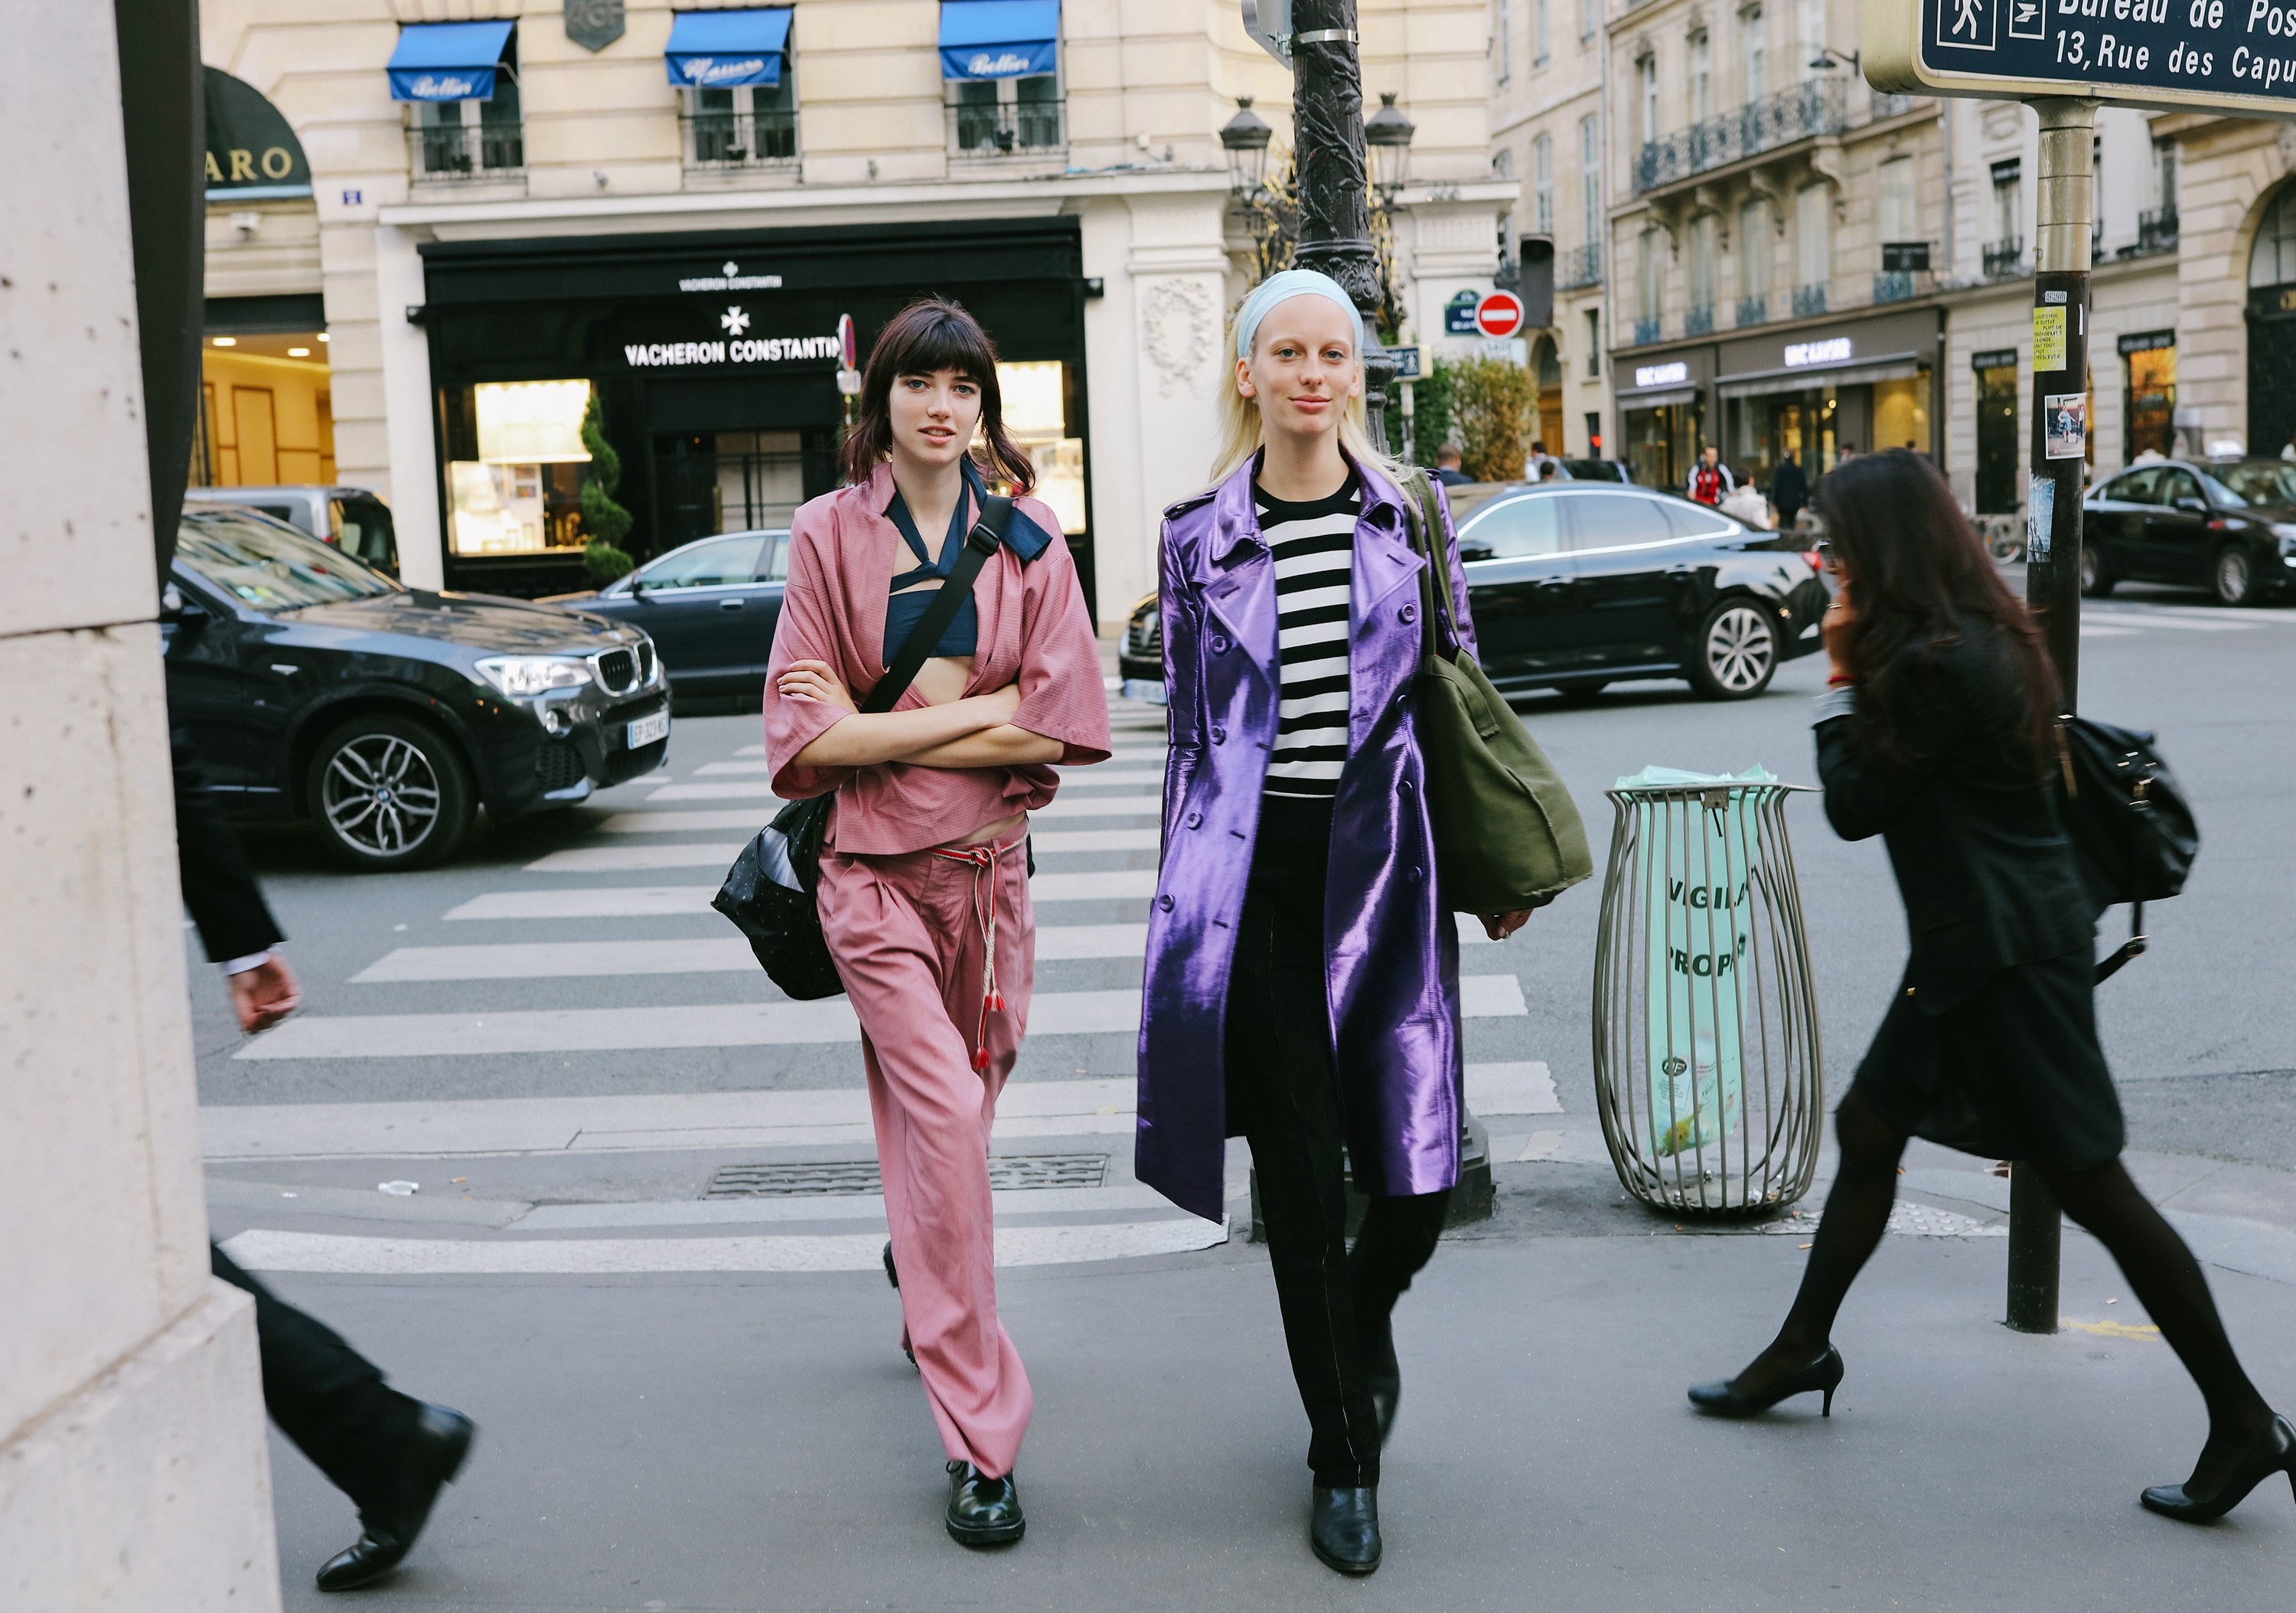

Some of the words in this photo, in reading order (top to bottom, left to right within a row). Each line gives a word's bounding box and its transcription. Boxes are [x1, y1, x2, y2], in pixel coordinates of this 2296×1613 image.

[2189, 0, 2224, 29] de
[2247, 0, 2296, 38] Pos
[2168, 41, 2214, 76] des
[2232, 46, 2296, 90] Capu
[204, 146, 293, 181] ARO
[625, 341, 726, 366] VACHERON
[729, 337, 841, 363] CONSTANTIN
